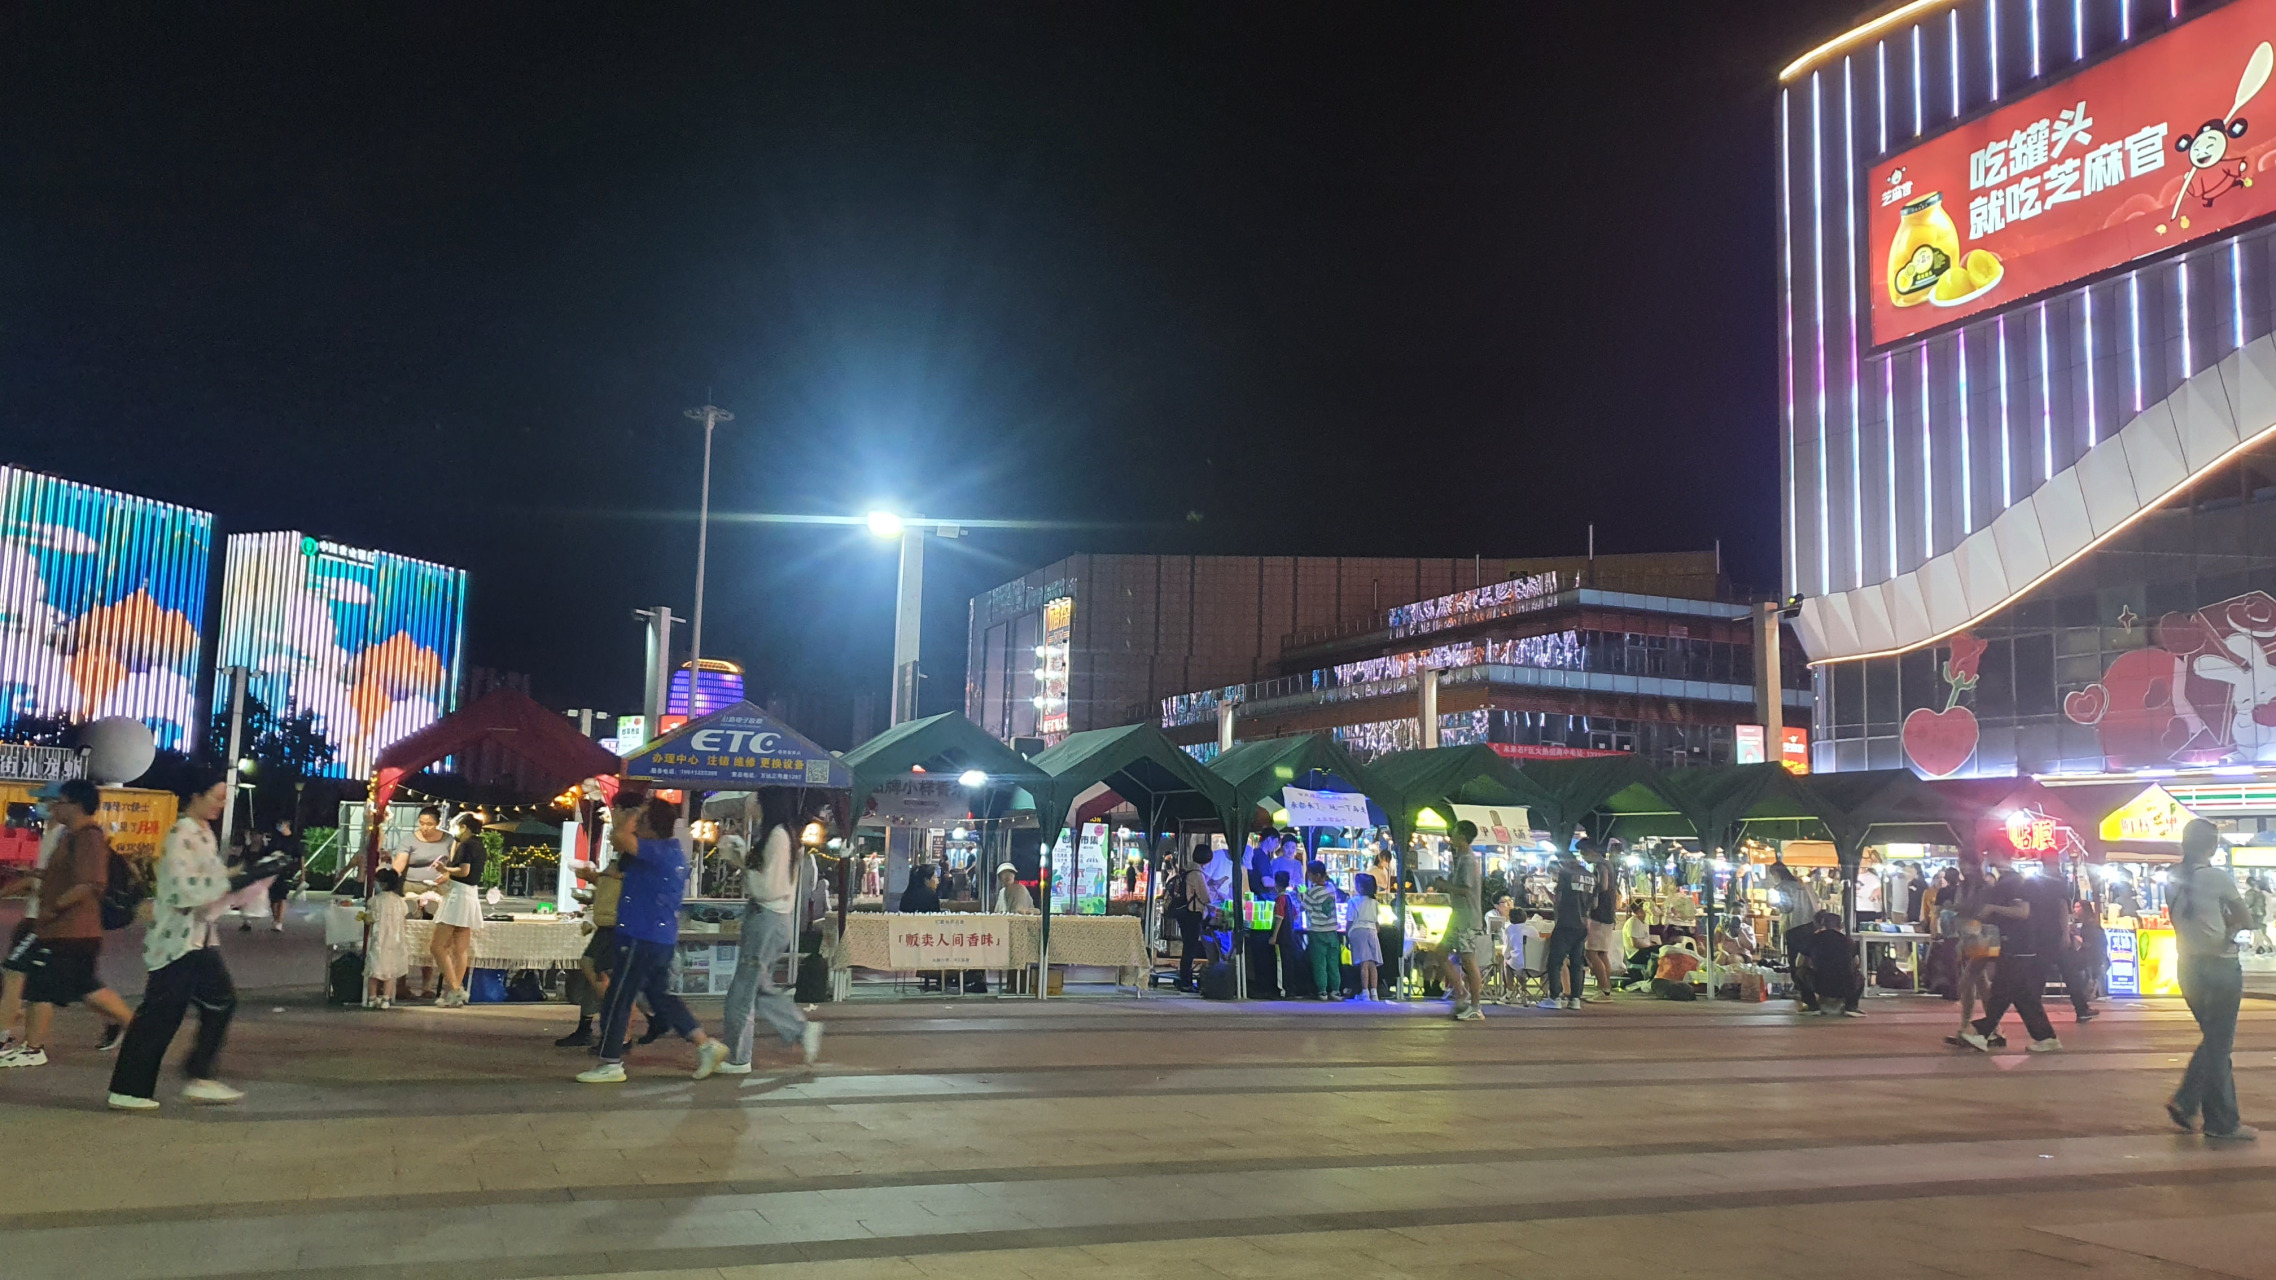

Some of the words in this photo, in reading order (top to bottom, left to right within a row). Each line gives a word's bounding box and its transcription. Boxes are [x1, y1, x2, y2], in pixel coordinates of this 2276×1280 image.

[1970, 101, 2093, 190] 吃罐头
[1881, 181, 1913, 207] 芝麻官
[1969, 122, 2168, 240] 就吃芝麻官
[691, 729, 782, 754] ETC
[652, 753, 699, 766] 办理中心
[707, 755, 730, 767] 注销
[734, 756, 756, 768] 维修
[760, 757, 805, 770] 更换设备
